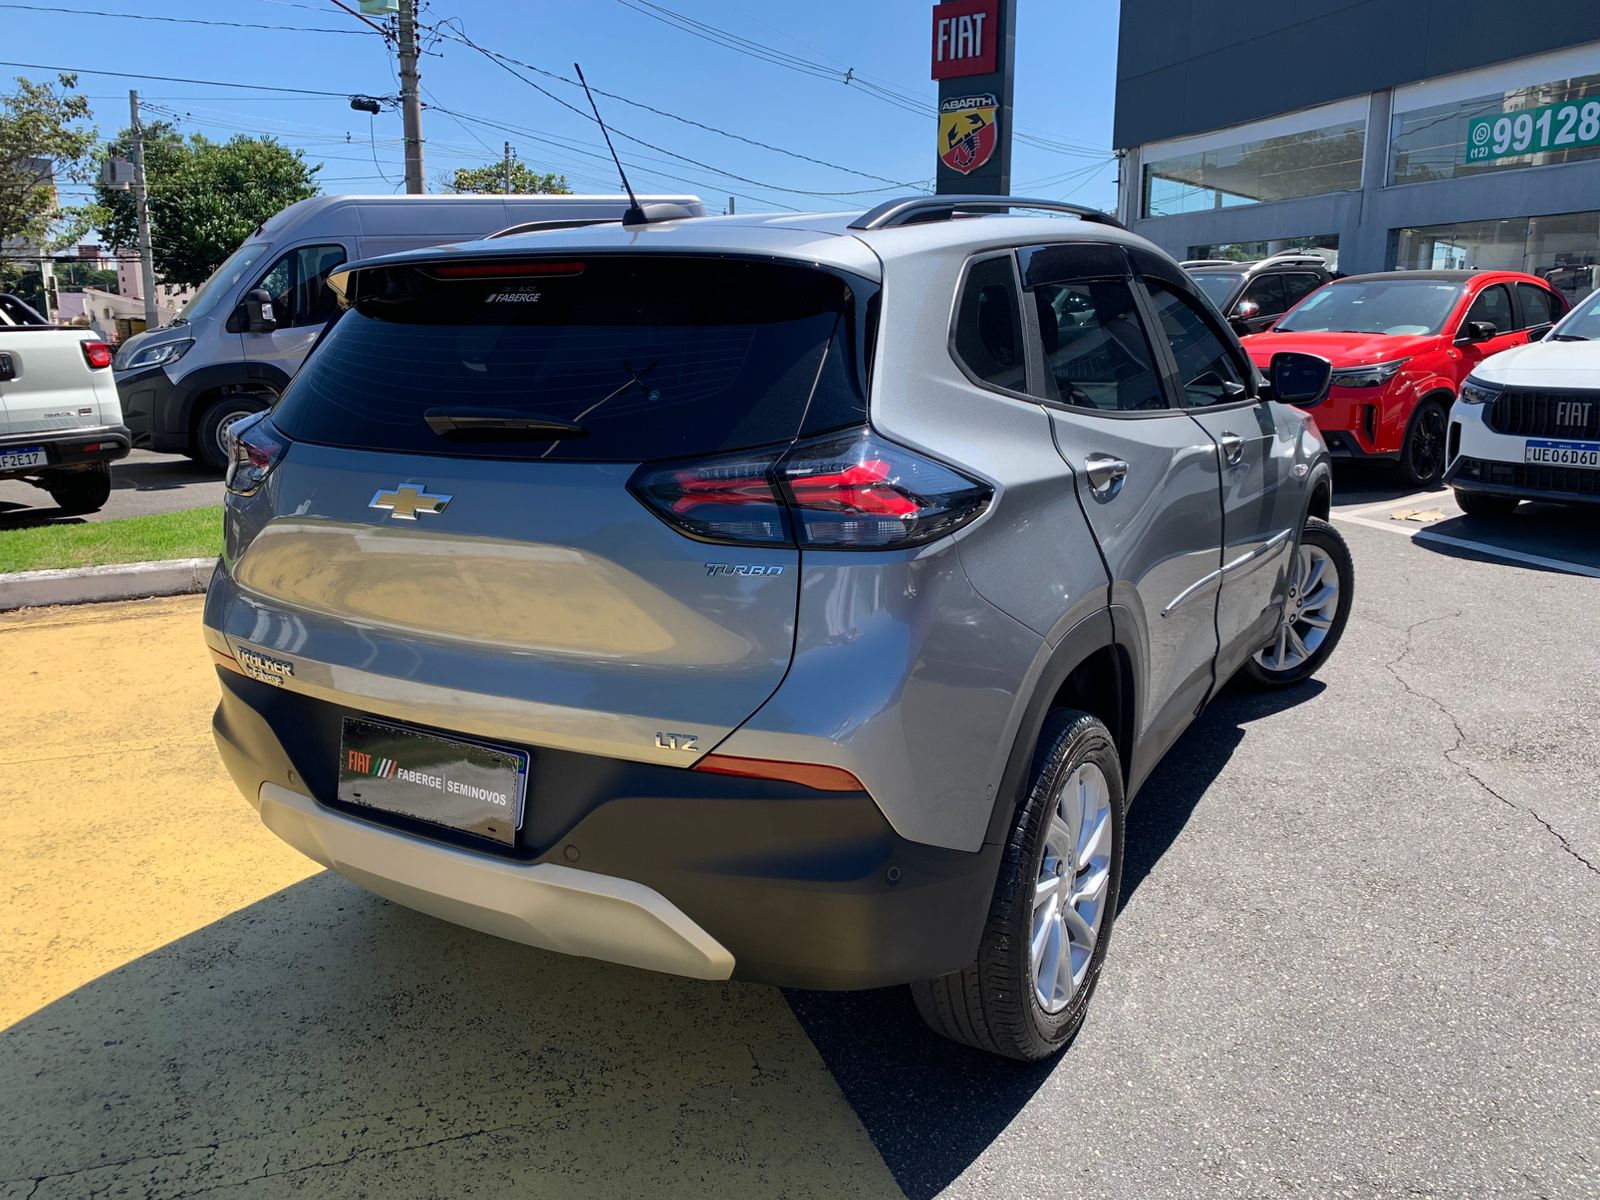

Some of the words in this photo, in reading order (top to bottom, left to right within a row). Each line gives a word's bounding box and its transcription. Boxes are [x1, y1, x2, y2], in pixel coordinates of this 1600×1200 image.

[937, 12, 986, 62] FIAT
[941, 97, 992, 111] ABARTH
[1470, 146, 1489, 159] (12)
[1492, 101, 1600, 154] 99128
[495, 293, 541, 302] FABERGE
[1556, 401, 1592, 427] FIAT
[0, 453, 39, 468] F2E17
[704, 562, 784, 577] TURBO
[237, 646, 295, 677] TRACKER
[655, 731, 699, 751] LTZ
[348, 750, 371, 774] FIAT
[397, 768, 442, 789] FABERGE
[447, 780, 507, 806] SEMINOVOS
